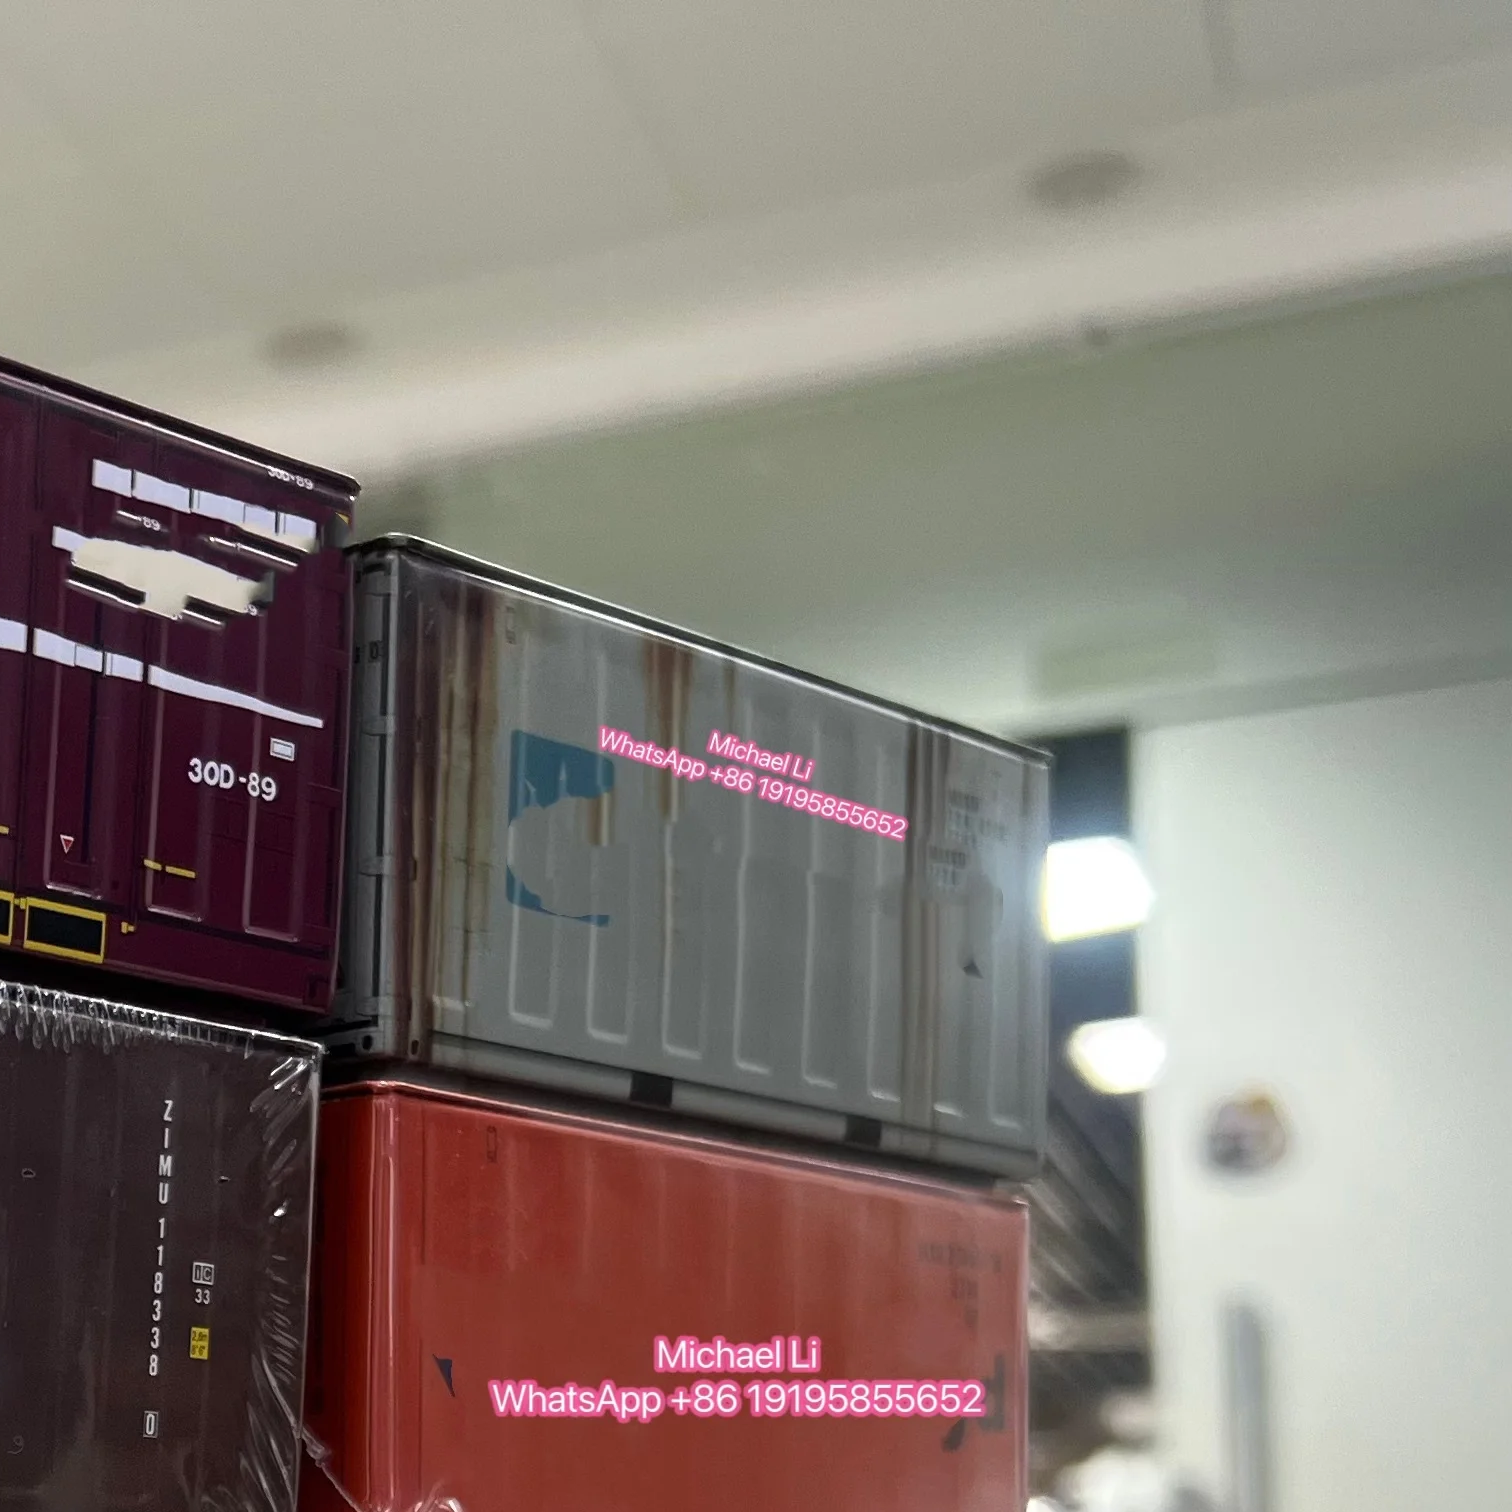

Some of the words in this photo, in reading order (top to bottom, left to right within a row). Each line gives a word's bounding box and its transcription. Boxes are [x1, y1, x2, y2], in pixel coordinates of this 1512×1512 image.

[158, 1100, 174, 1204] ZIMU
[149, 1217, 166, 1377] 118338
[194, 1288, 210, 1305] 33
